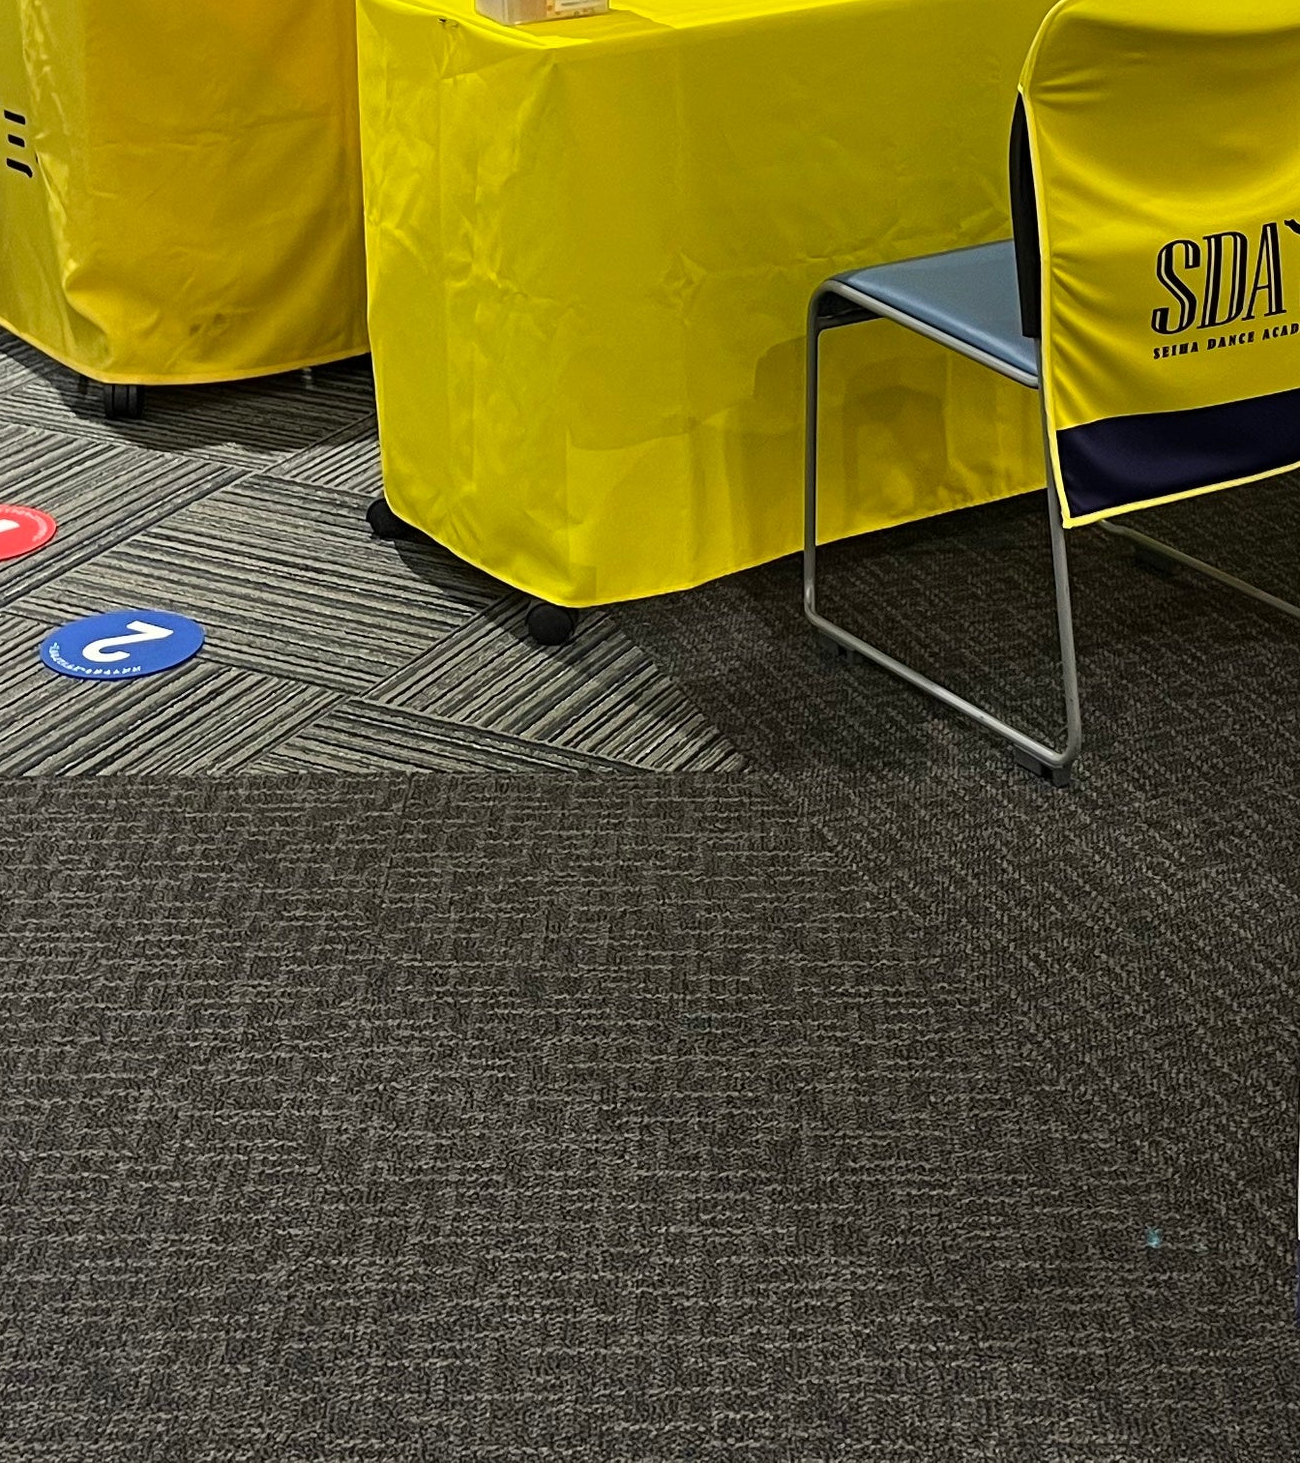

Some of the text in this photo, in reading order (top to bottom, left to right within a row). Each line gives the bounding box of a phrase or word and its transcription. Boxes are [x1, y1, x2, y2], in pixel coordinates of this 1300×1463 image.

[1150, 222, 1288, 336] SDA
[1153, 340, 1200, 360] SEIHA
[1207, 332, 1255, 350] DANCE
[82, 621, 174, 663] 2
